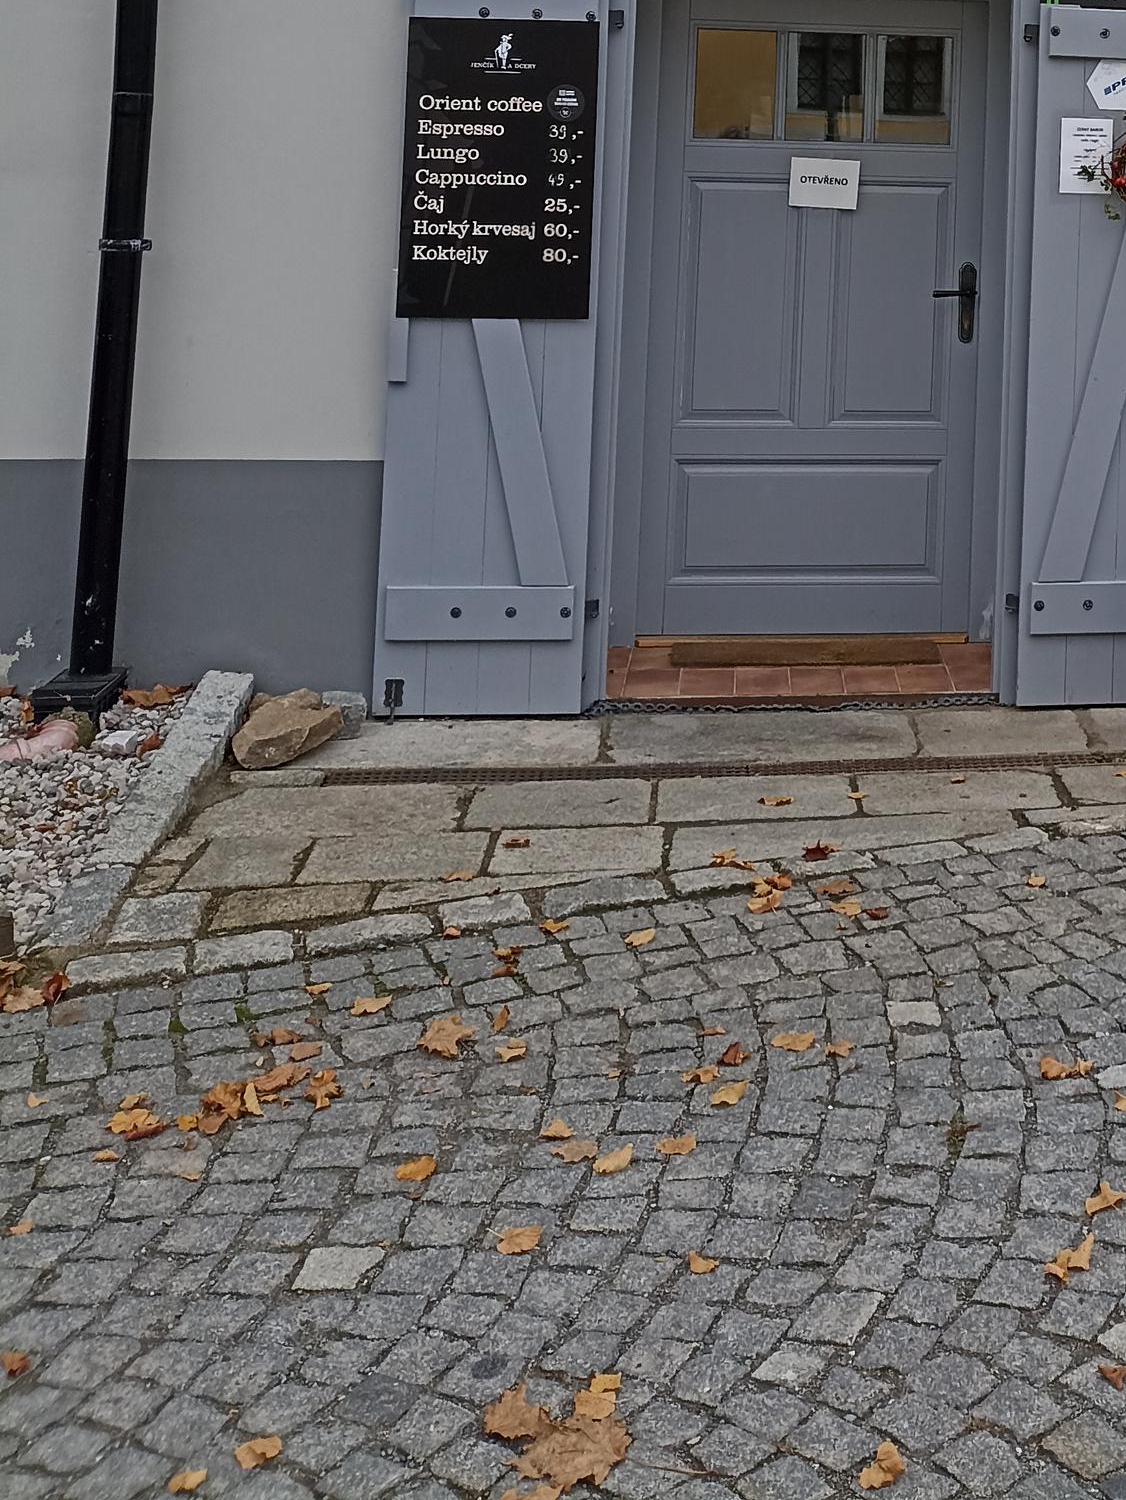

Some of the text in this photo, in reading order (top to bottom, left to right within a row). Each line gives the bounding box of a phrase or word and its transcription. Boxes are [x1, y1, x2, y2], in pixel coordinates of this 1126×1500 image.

[419, 94, 543, 112] Orient coffee
[417, 119, 505, 139] Espresso
[416, 143, 480, 164] Lungo
[415, 168, 528, 189] Cappuccino
[800, 174, 848, 186] OTEVŘENO
[413, 190, 580, 215] Čaj 25,-
[413, 220, 580, 241] Horký krvesaj 60,-
[412, 245, 579, 265] Koktejly 80,-
